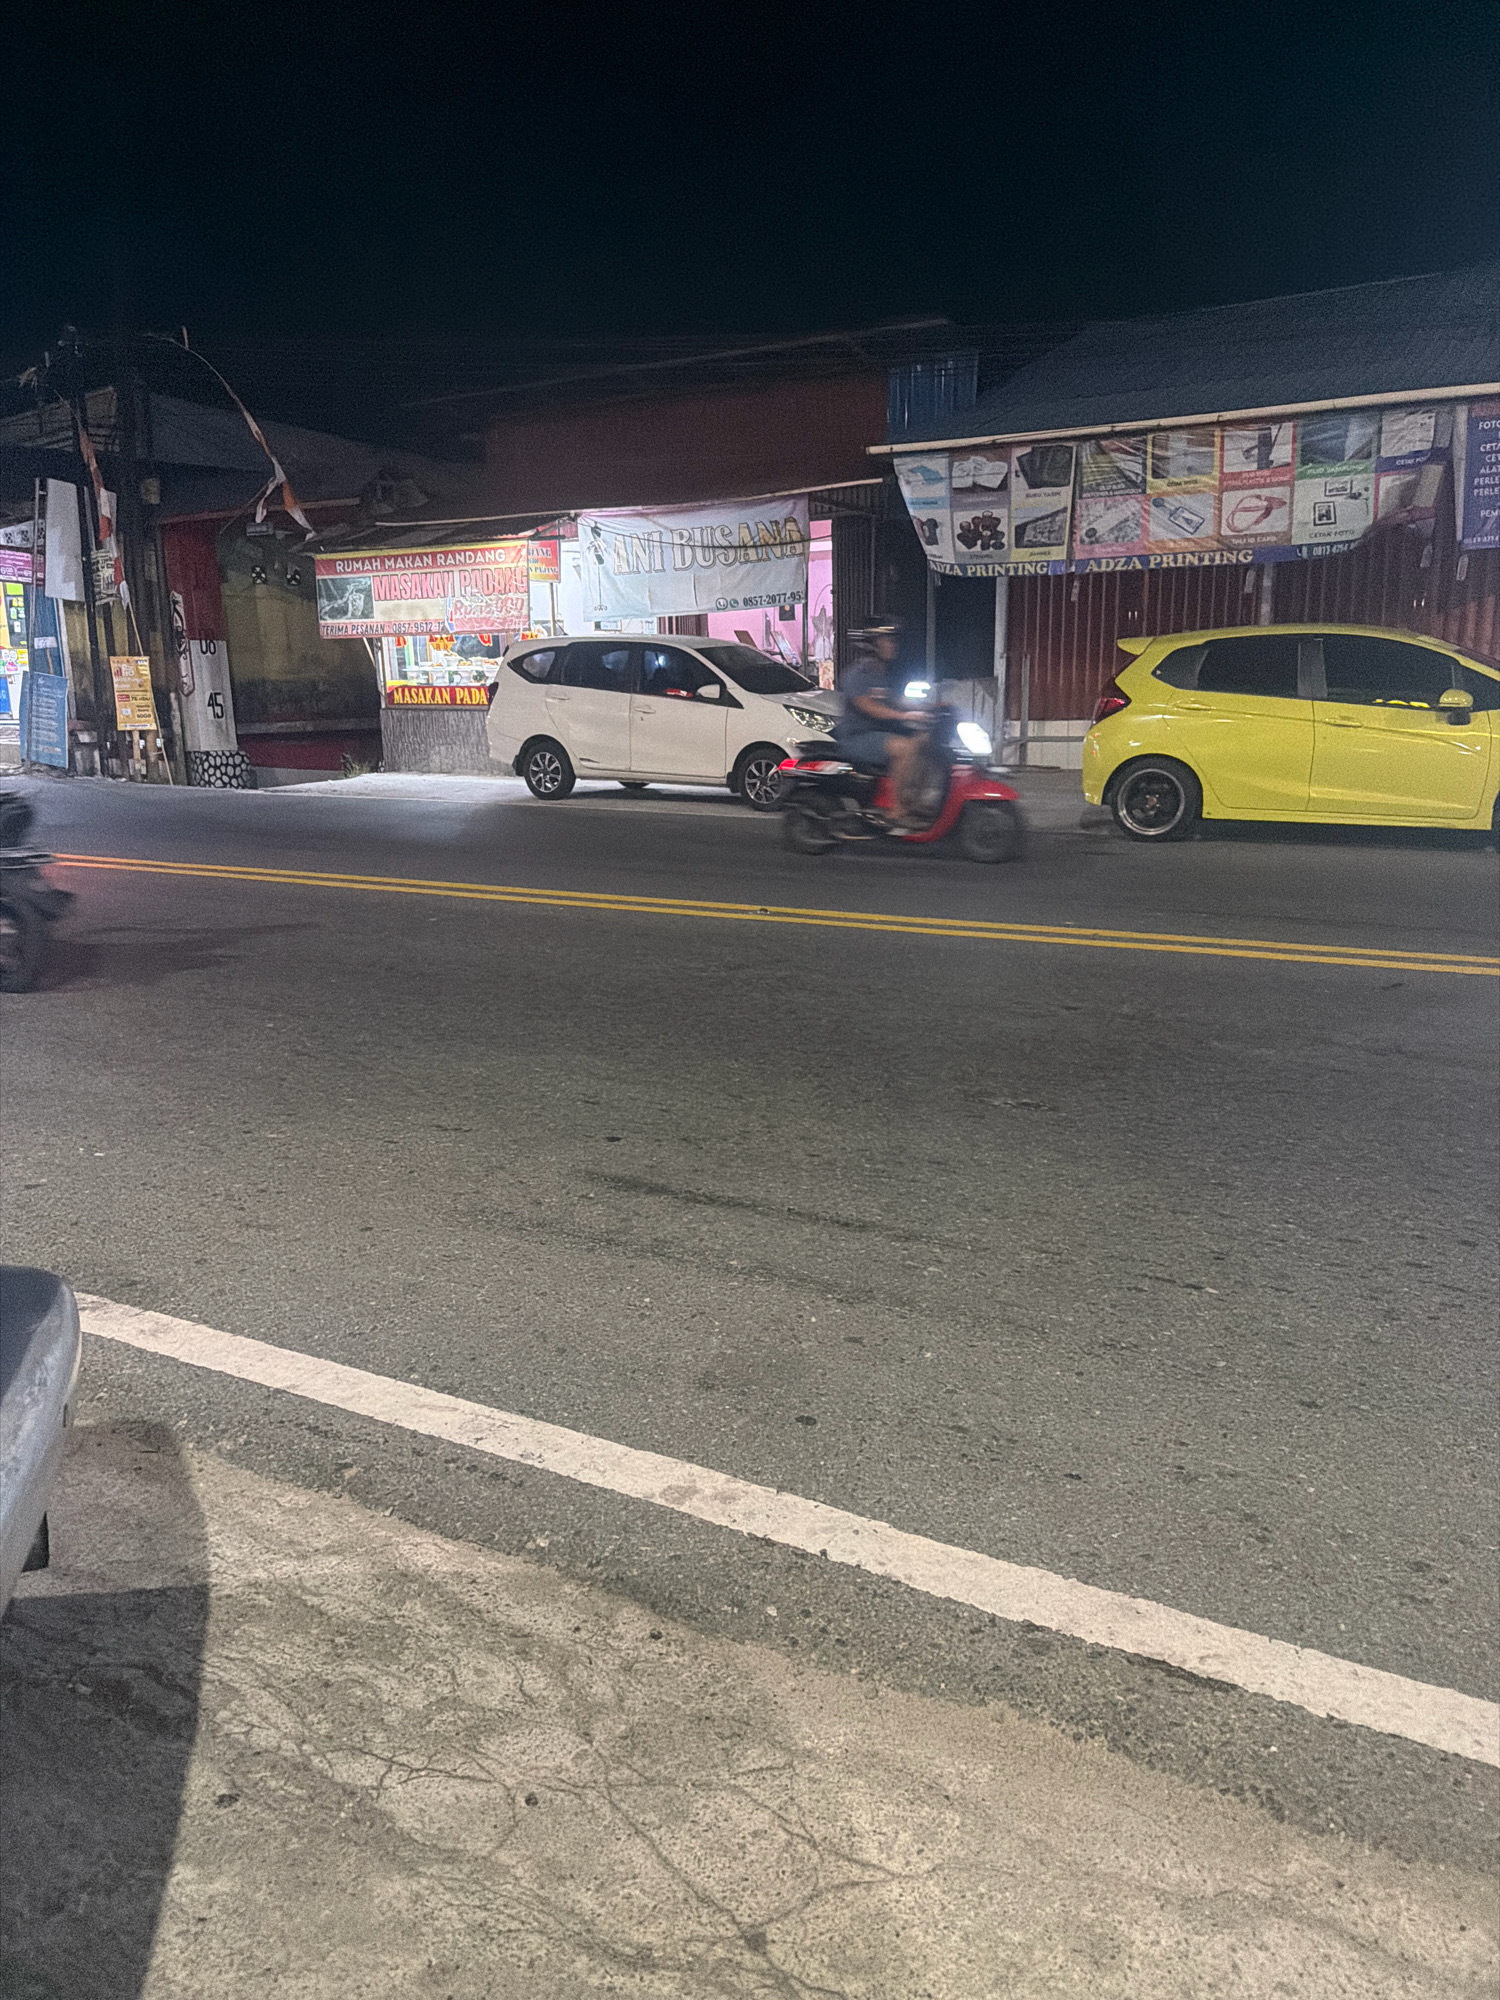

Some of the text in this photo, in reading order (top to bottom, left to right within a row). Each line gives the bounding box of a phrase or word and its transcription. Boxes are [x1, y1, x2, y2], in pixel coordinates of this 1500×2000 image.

[613, 516, 806, 576] ANI BUSANA
[335, 549, 506, 574] RUMAH MAKAN RANDANG
[929, 560, 1049, 577] ADZA PRINTING
[1085, 556, 1143, 573] ADZA
[1148, 549, 1254, 569] PRINTING
[372, 565, 528, 601] MASAKAN PADANG
[321, 624, 349, 636] TERIMA
[351, 623, 386, 635] PESANAN
[207, 692, 225, 719] 45
[393, 687, 489, 705] MASAKAN PADA
